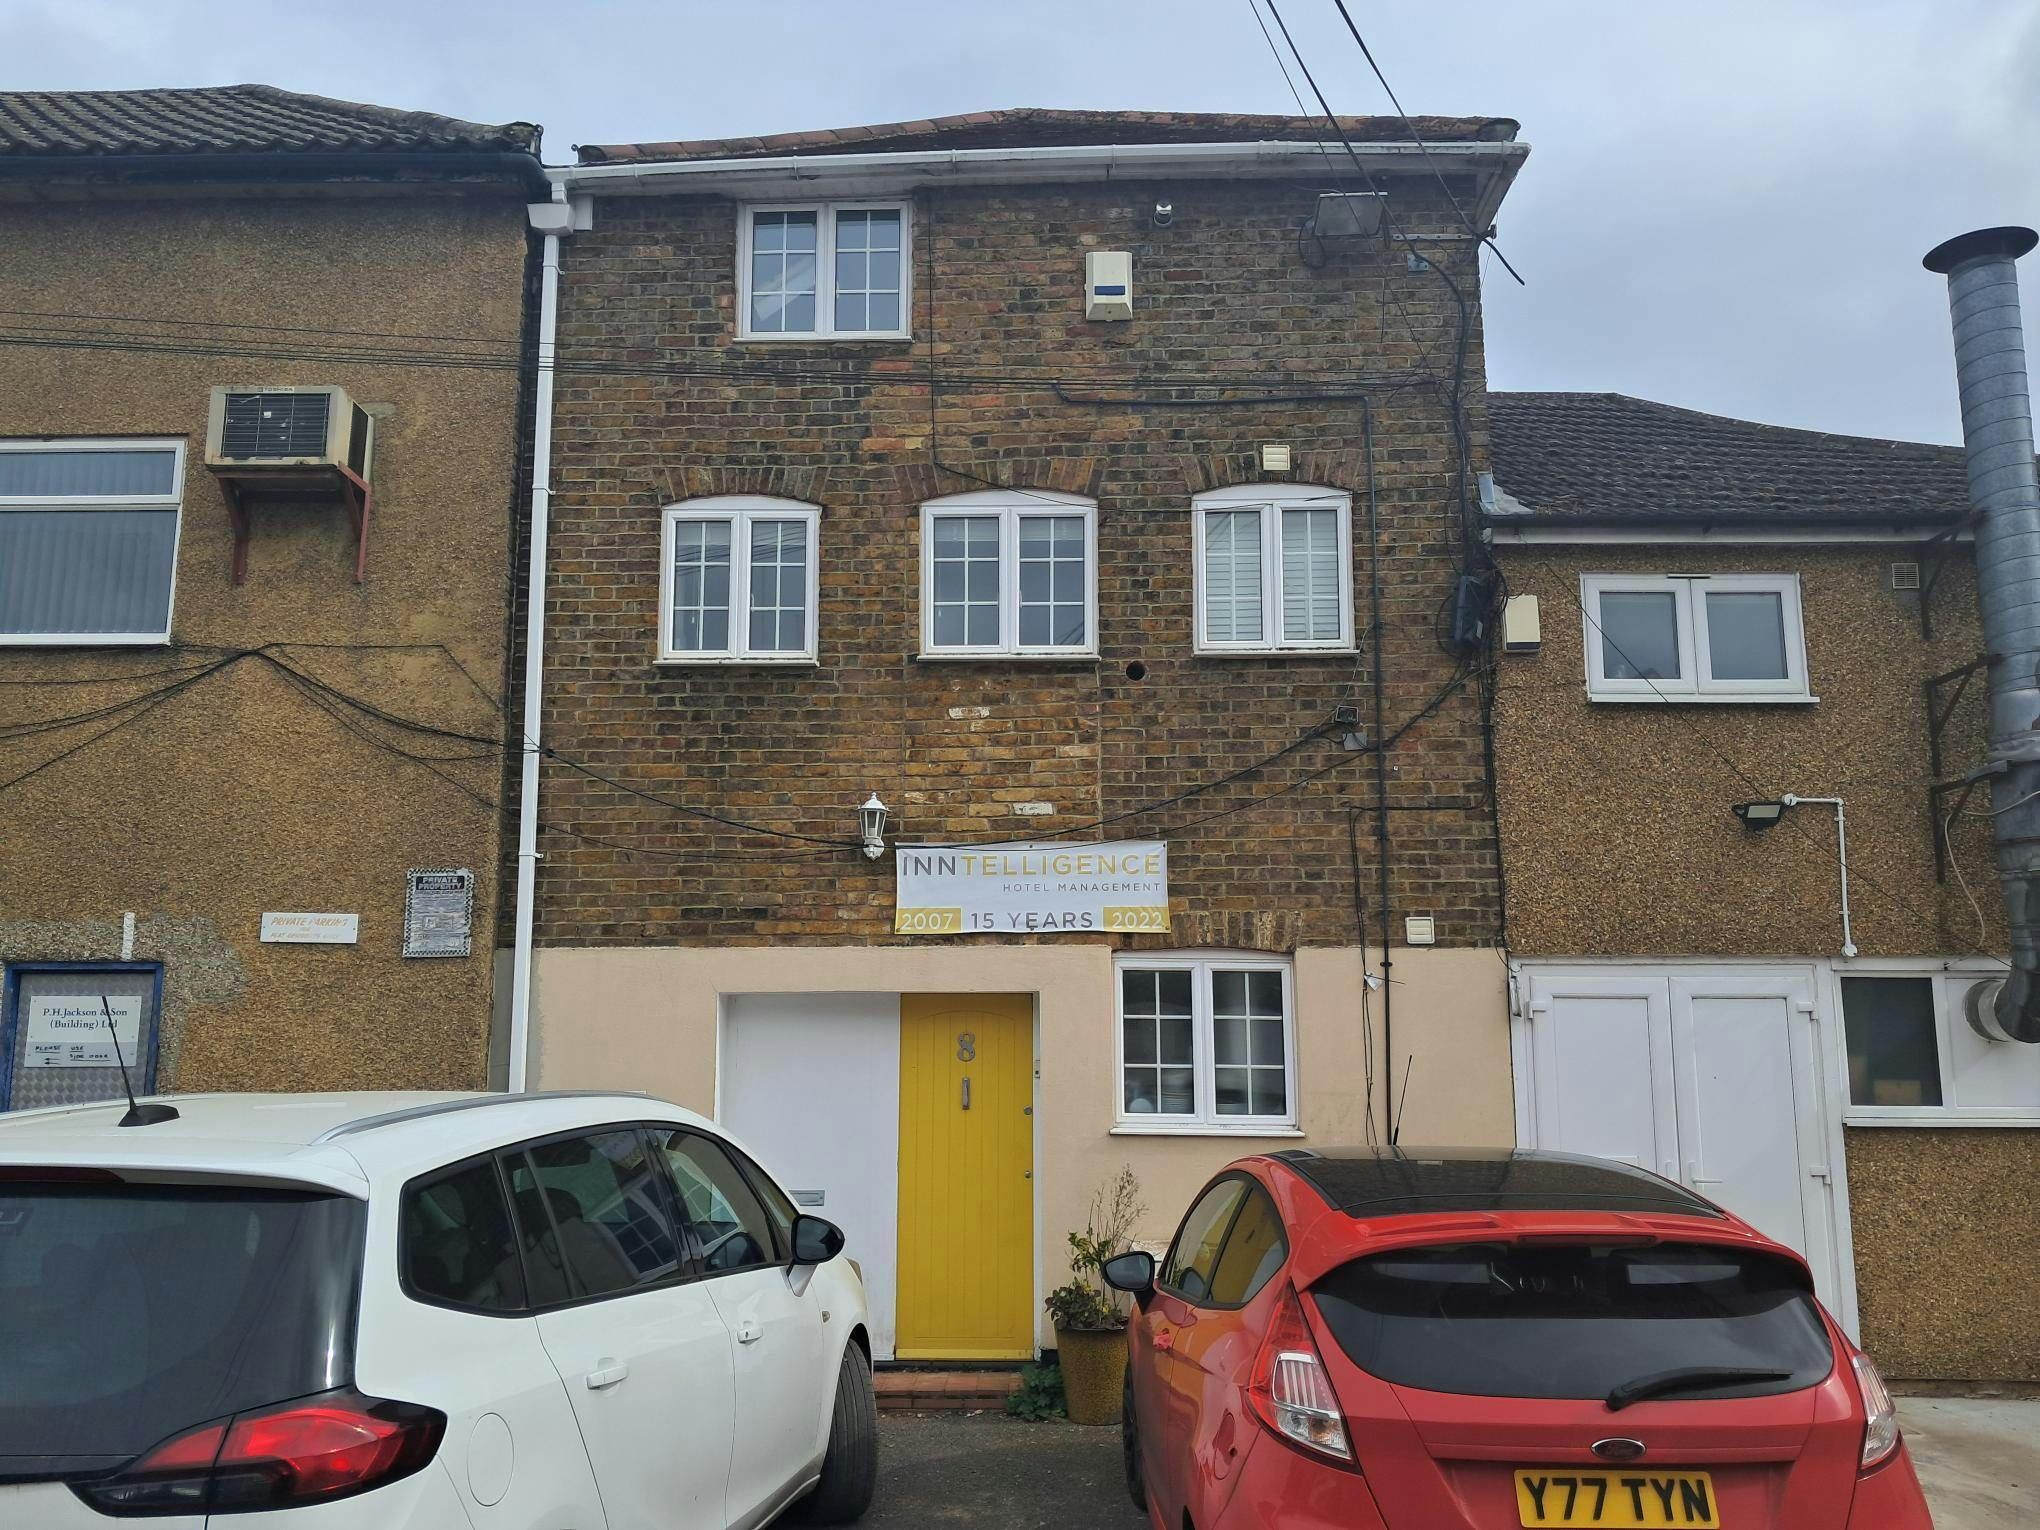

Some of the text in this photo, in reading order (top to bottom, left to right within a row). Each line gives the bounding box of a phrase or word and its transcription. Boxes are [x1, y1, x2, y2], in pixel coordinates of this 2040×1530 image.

[903, 854, 1161, 876] INNTELLIGENCE
[1003, 883, 1161, 892] HOTEL MANAGEMENT
[271, 917, 308, 925] PRIVATE
[901, 911, 1162, 930] 2007 15 YEARS 2022
[110, 1008, 128, 1016] Son
[50, 1019, 118, 1030] (Building) Ld
[957, 1032, 976, 1062] 8
[1522, 1477, 1712, 1522] Y77 TYN
